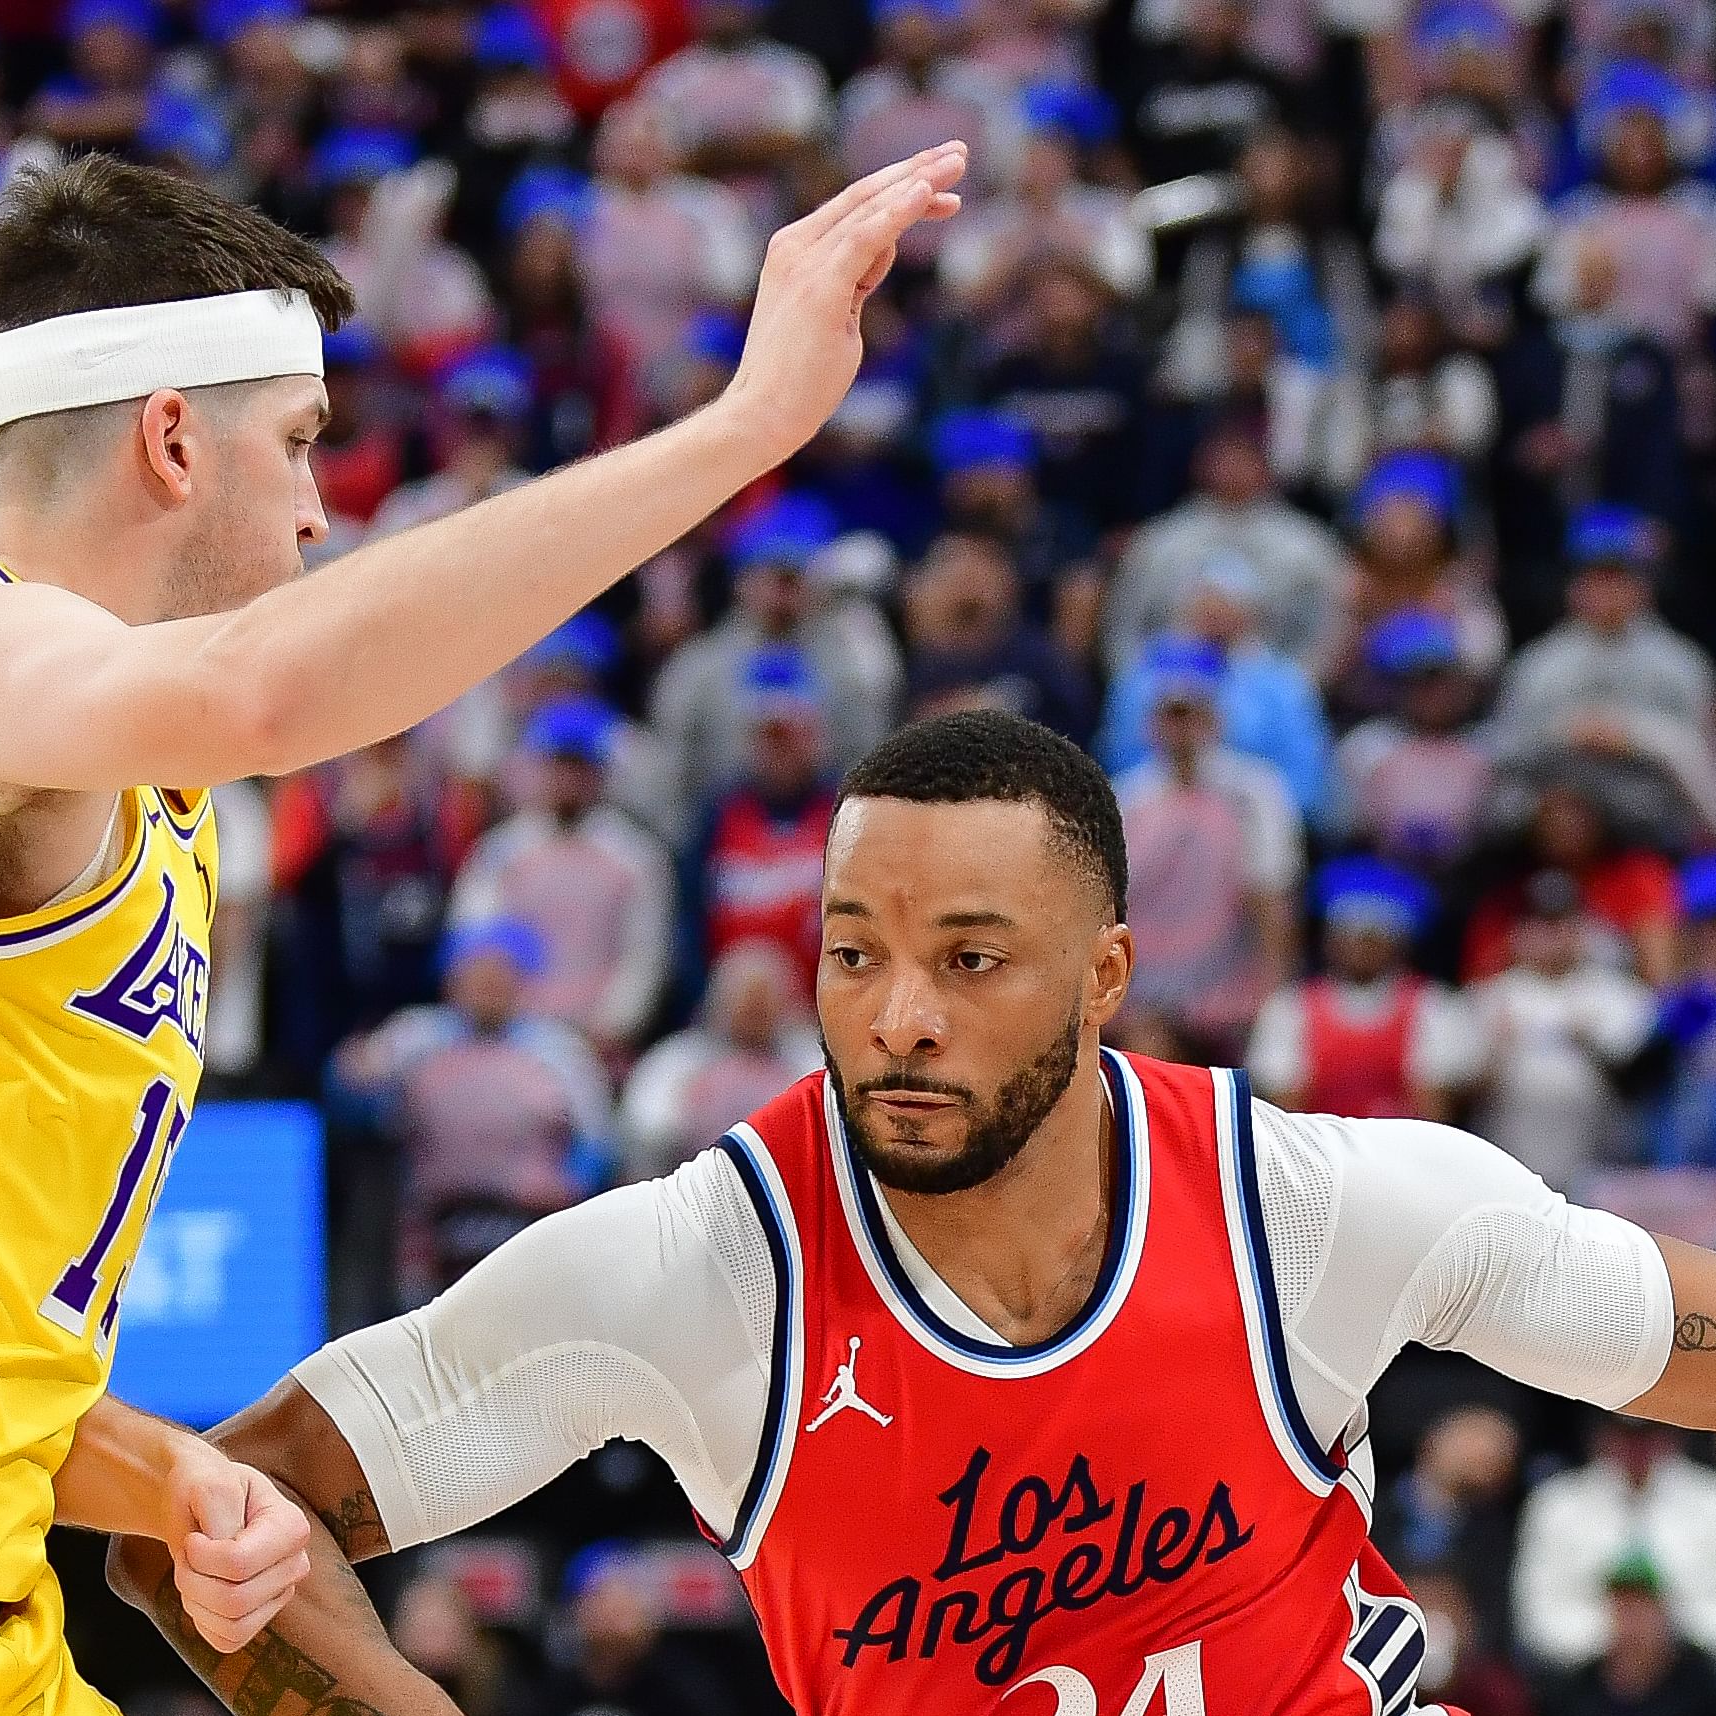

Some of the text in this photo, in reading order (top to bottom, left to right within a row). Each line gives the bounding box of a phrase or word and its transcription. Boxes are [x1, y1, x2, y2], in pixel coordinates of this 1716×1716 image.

[36, 1070, 191, 1360] 1
[833, 1480, 1255, 1686] Angeles
[934, 1446, 1114, 1581] Los
